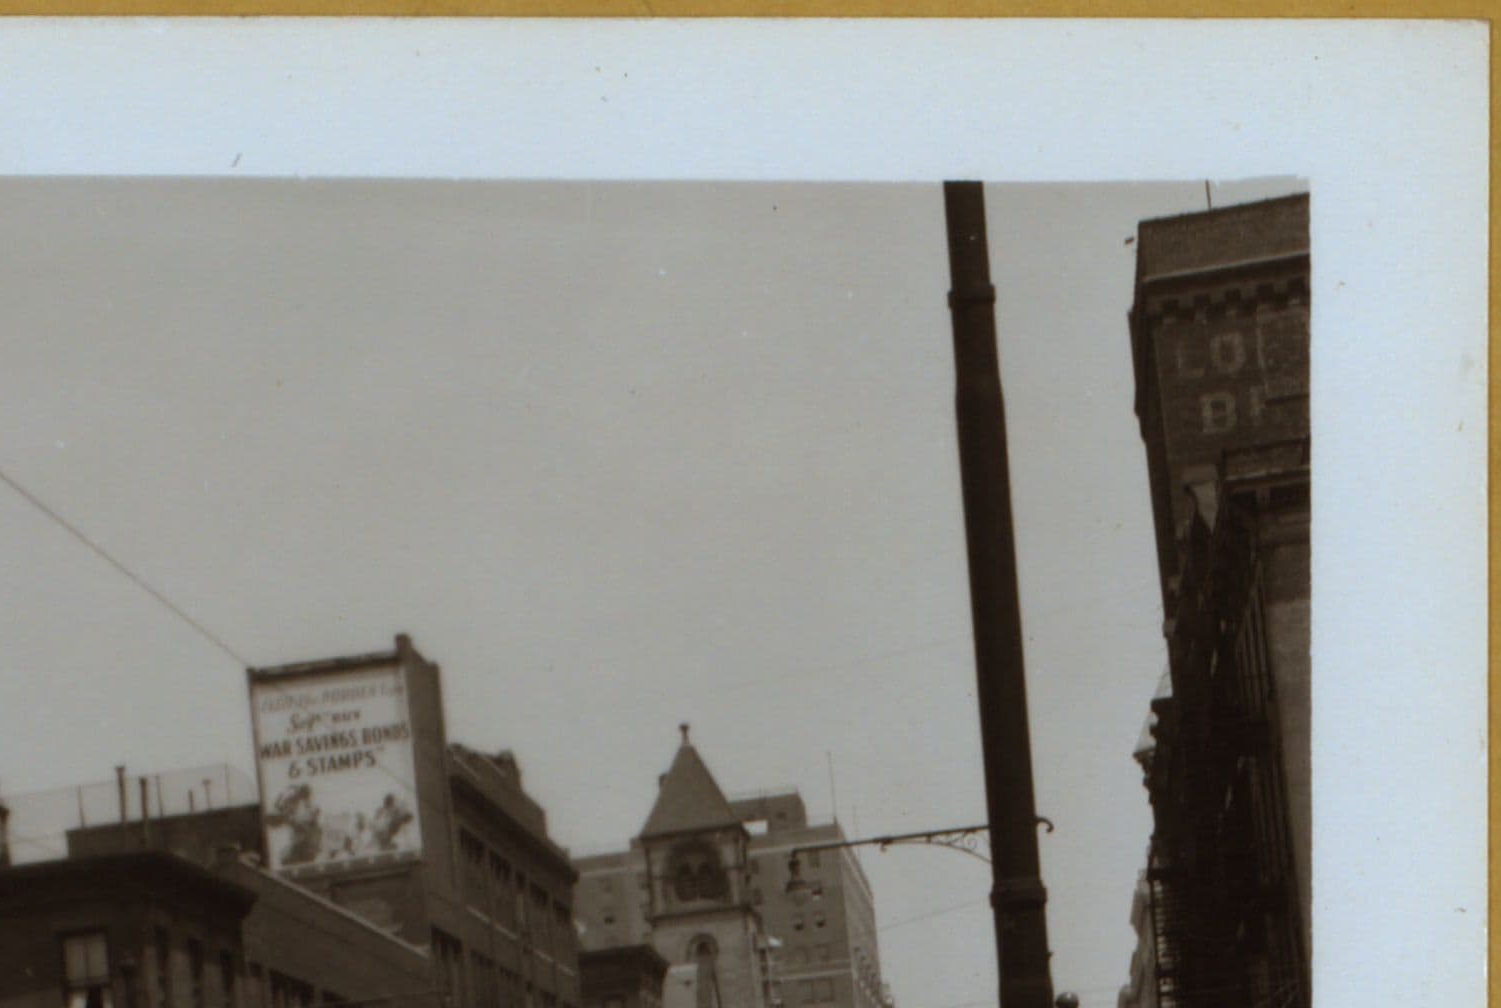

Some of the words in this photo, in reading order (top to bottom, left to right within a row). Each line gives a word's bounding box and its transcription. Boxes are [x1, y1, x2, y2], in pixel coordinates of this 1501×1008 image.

[259, 740, 292, 760] WAR
[296, 728, 358, 755] SAVINGS
[362, 722, 410, 746] BONDS
